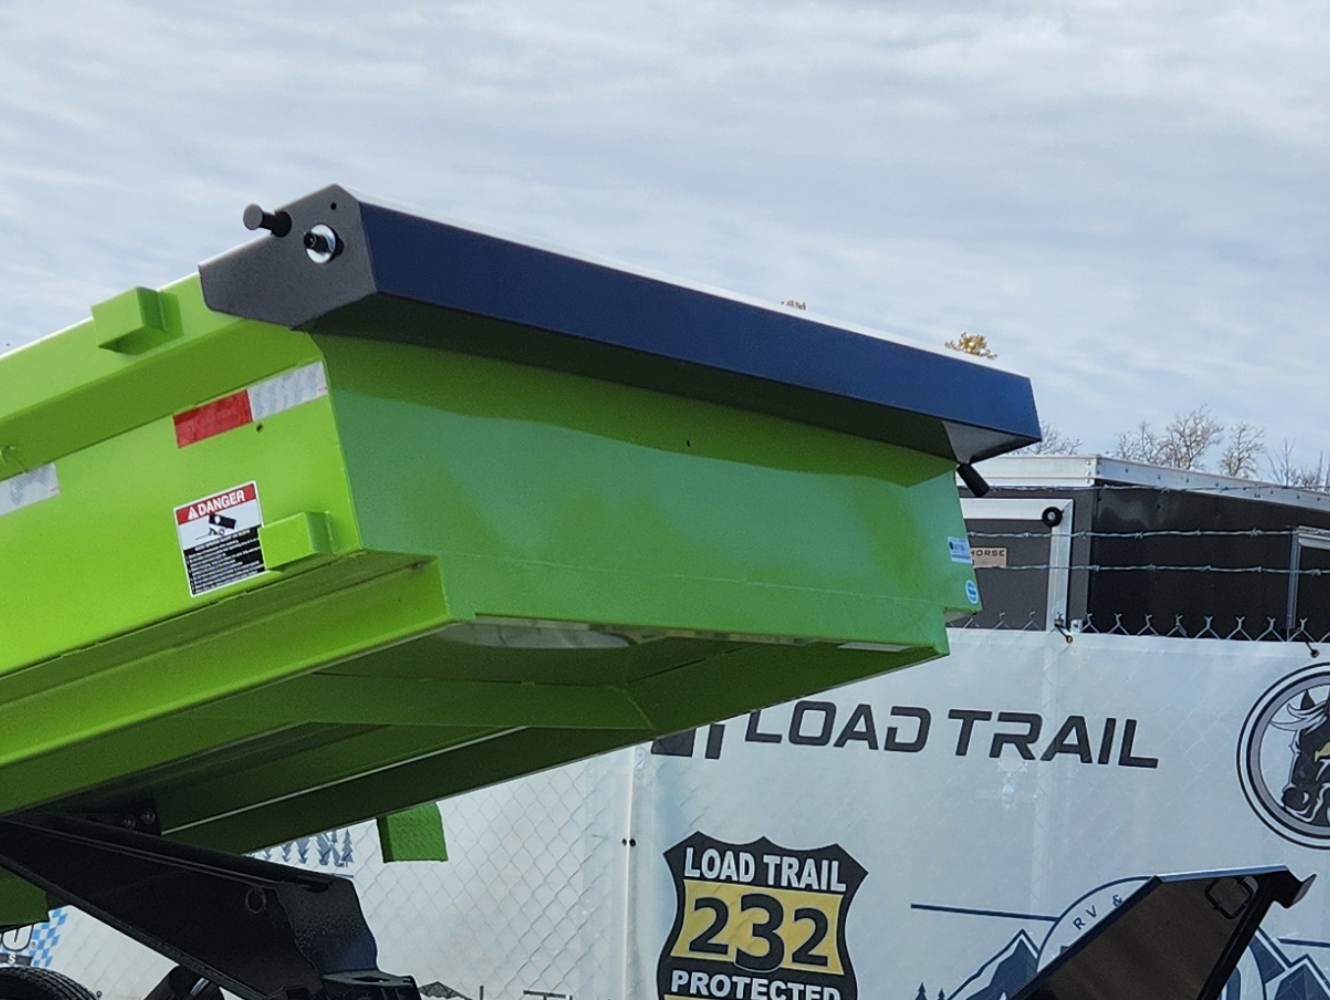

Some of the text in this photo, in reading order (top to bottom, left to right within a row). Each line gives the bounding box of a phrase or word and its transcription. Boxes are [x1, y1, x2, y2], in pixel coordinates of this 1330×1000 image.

[197, 489, 246, 517] DANGER
[744, 700, 1159, 769] LOAD TRAIL
[683, 847, 847, 892] LOAD TRAIL
[688, 893, 829, 972] 232
